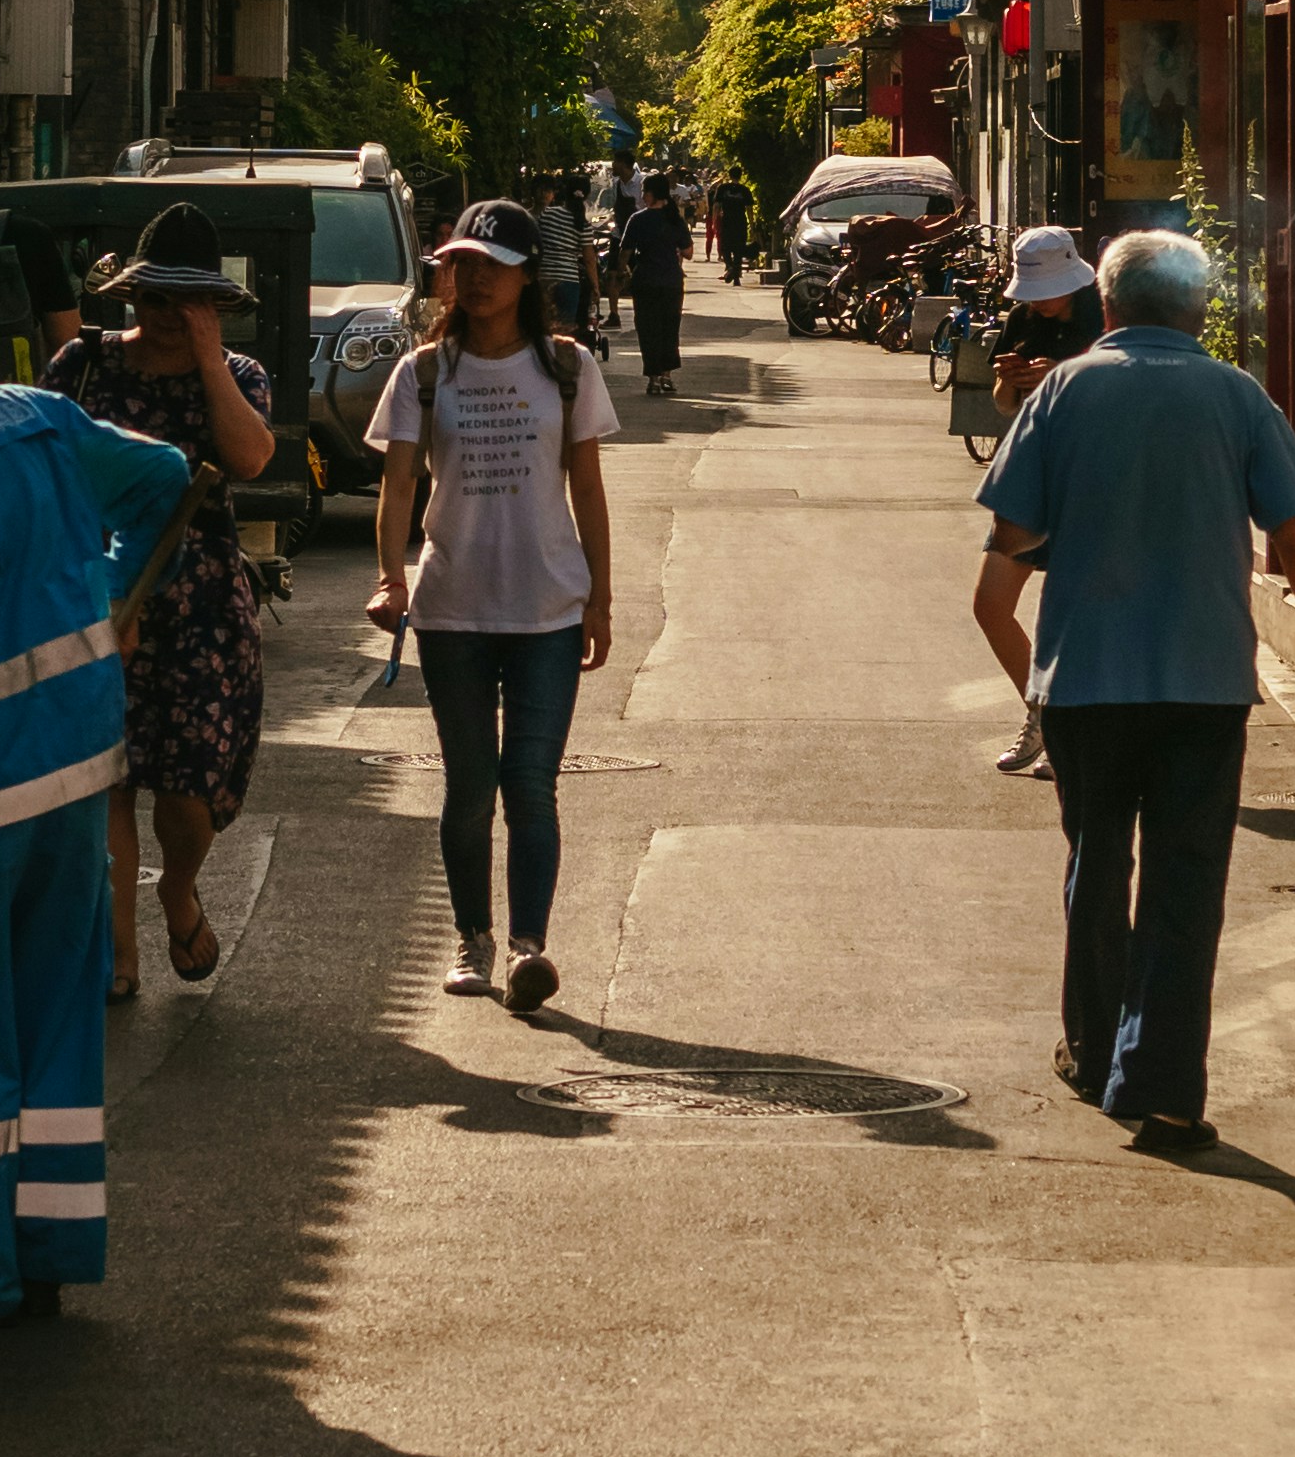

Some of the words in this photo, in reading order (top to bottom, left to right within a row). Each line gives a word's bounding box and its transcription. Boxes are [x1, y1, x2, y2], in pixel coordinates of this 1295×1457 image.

[471, 213, 498, 237] NY
[457, 386, 504, 397] MONDAY
[458, 402, 514, 413] TUESDAY
[457, 417, 530, 429] WEDNESDAY
[460, 434, 522, 445] THURSDAY
[461, 452, 507, 462] FRIDAY
[462, 468, 522, 479] SATURDAY
[462, 486, 507, 496] SUNDAY
